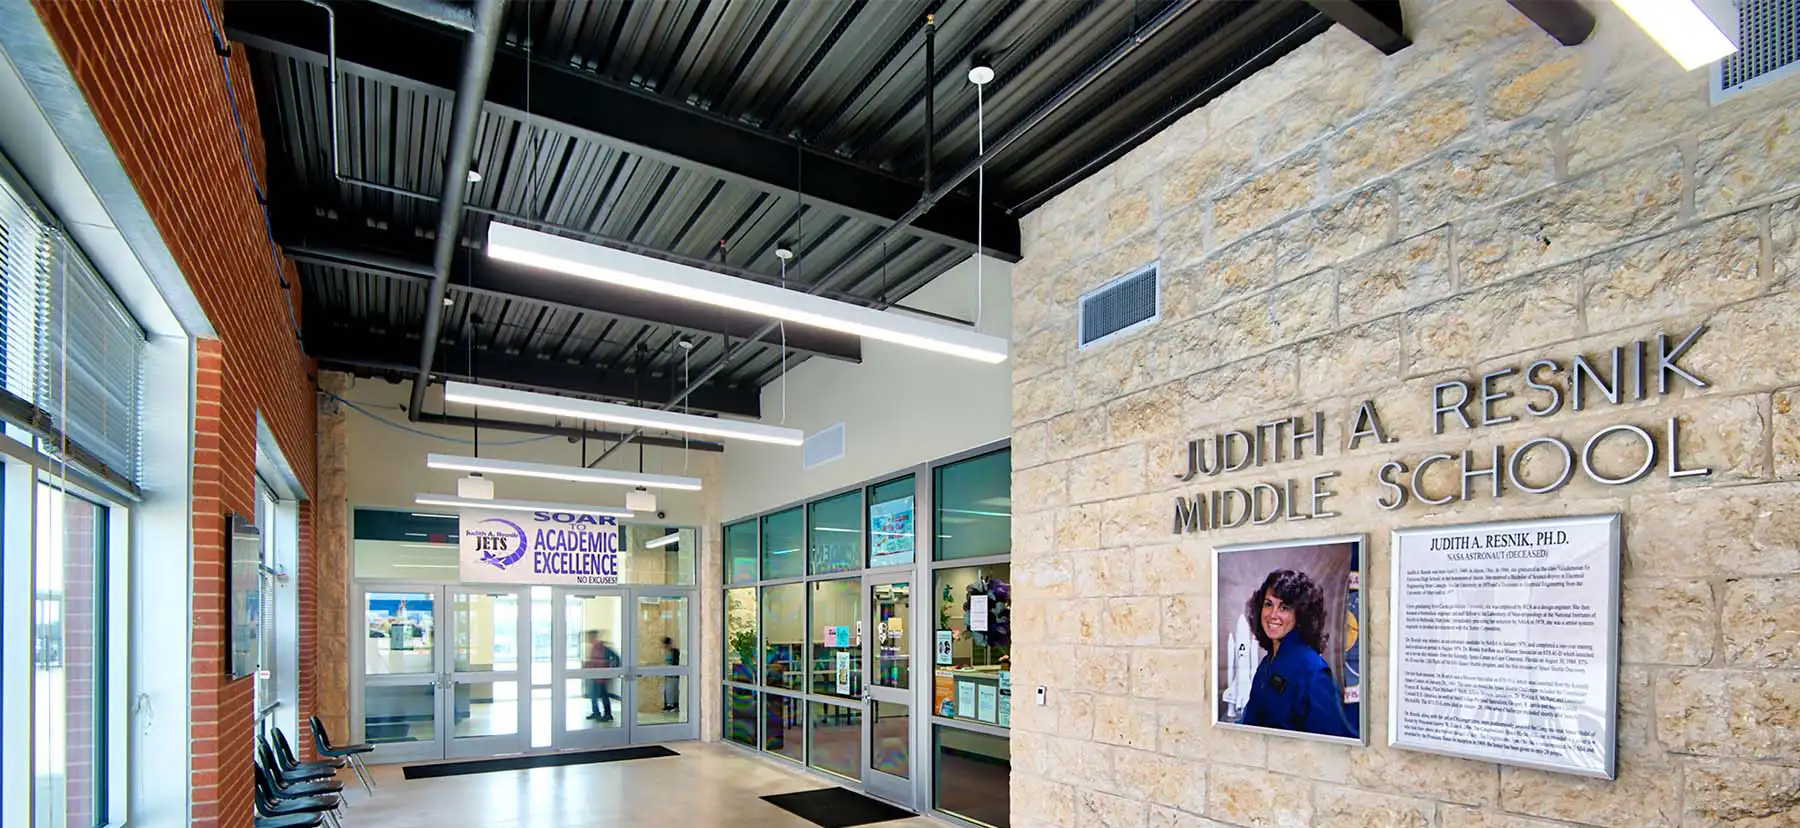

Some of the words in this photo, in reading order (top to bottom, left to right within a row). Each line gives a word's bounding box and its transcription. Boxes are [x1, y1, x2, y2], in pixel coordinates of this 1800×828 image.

[1174, 410, 1325, 482] JUDITH
[1347, 399, 1399, 450] A.
[1432, 324, 1709, 435] RESNIK
[1172, 471, 1339, 535] MIDDLE
[1377, 417, 1713, 511] SCHOOL
[534, 511, 617, 526] SOAR
[475, 537, 507, 551] JETS
[534, 529, 617, 553] ACADEMIC
[1430, 536, 1469, 551] JUDITH
[1471, 535, 1483, 549] A.
[1486, 532, 1533, 548] RESNIK,
[1536, 530, 1569, 546] PH.D.
[534, 552, 618, 575] EXCELLENCE
[1464, 550, 1506, 560] ASTRONAUT
[1506, 549, 1549, 560] (DECEASED)
[577, 576, 588, 584] NO
[588, 576, 618, 585] EXCUSES!
